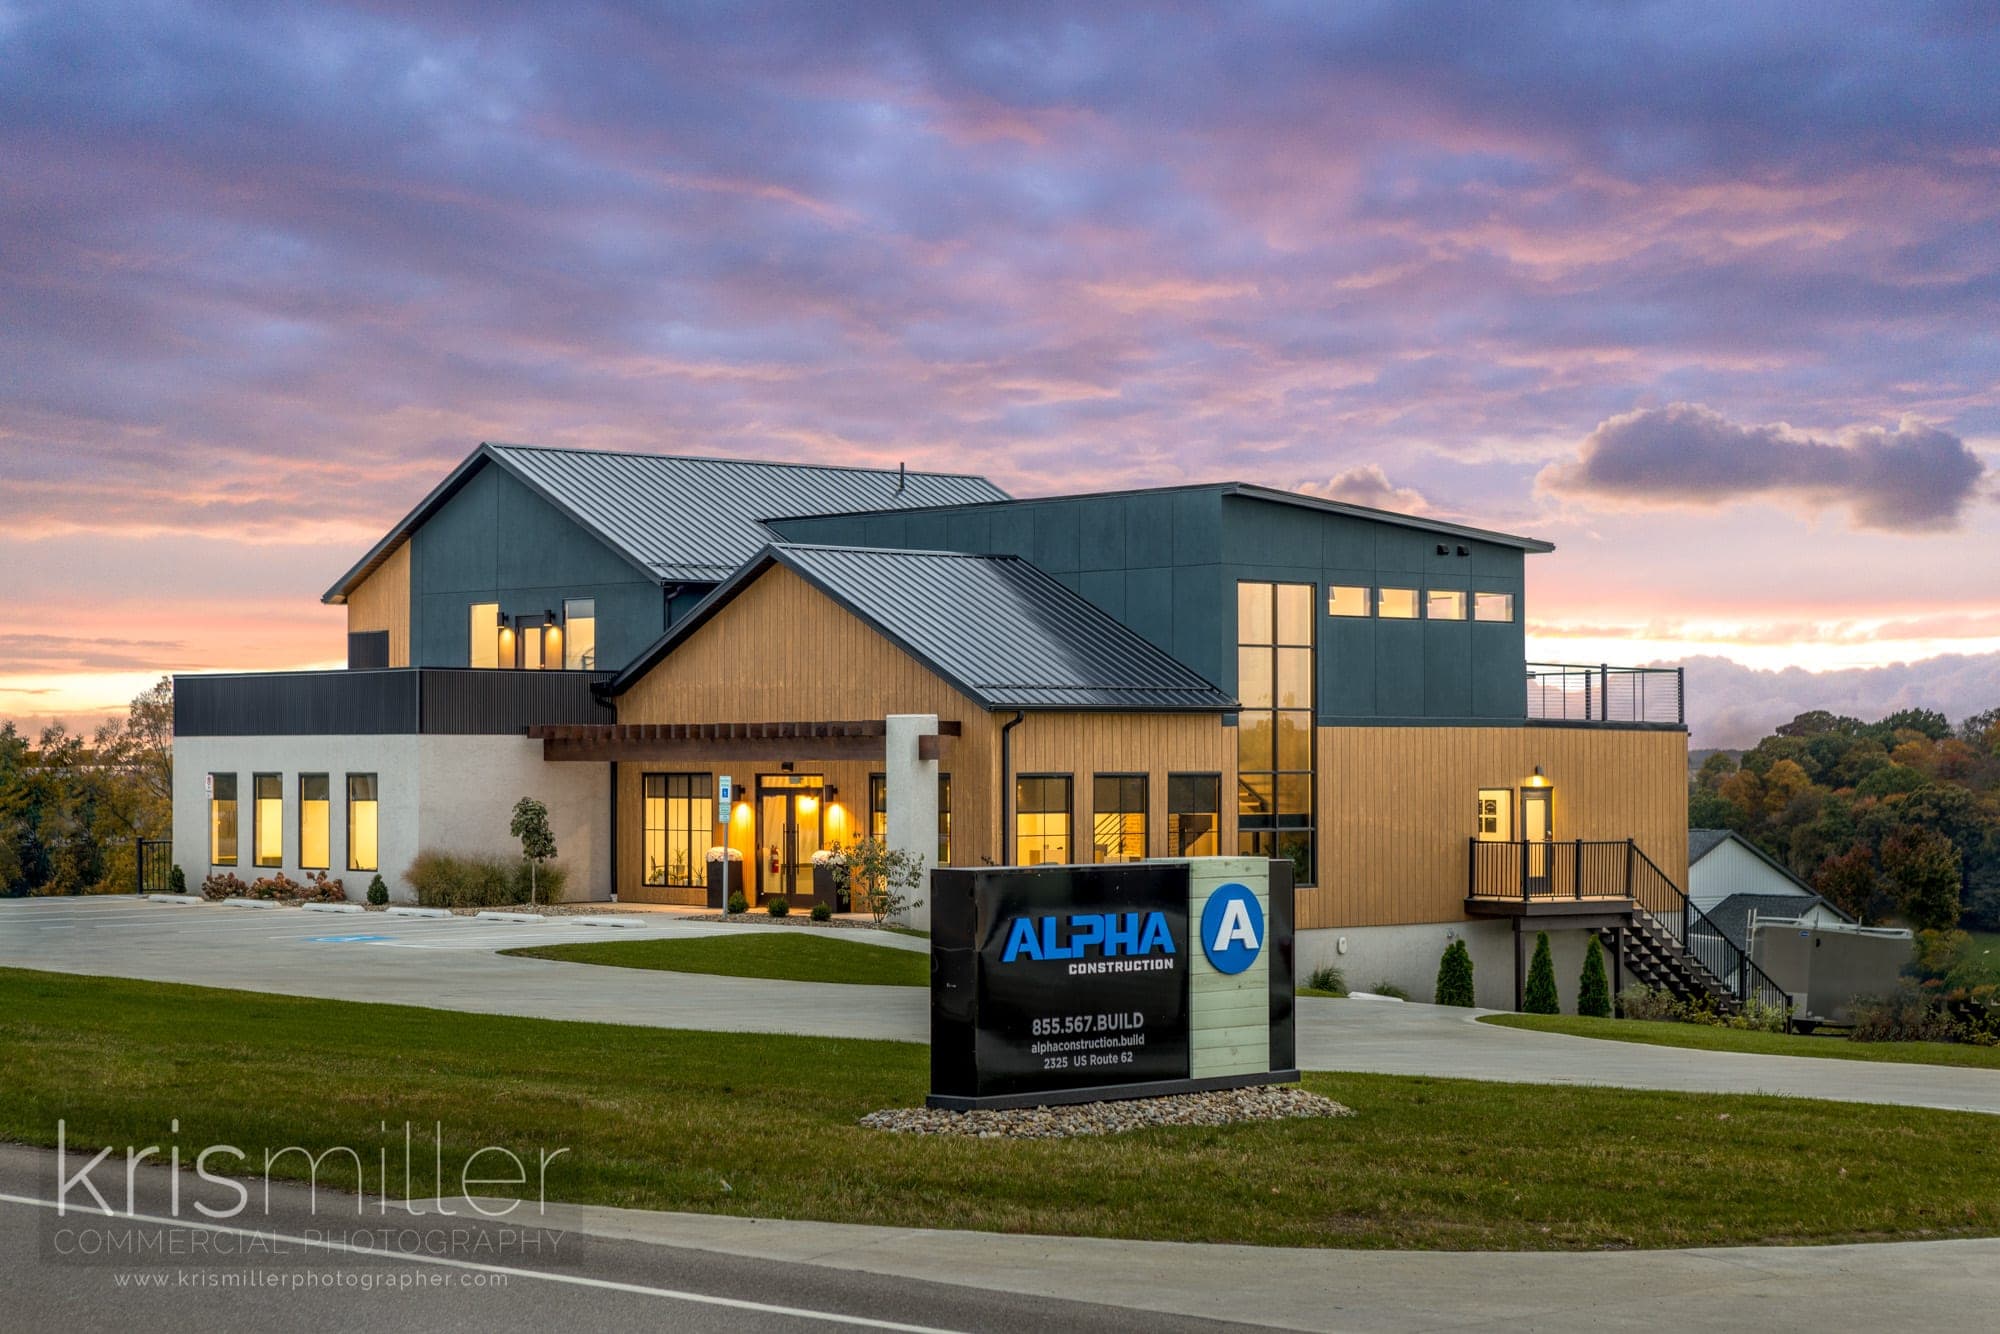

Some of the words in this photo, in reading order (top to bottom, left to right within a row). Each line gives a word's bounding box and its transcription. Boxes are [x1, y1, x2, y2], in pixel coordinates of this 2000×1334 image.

[1213, 899, 1260, 952] A
[1001, 911, 1177, 963] ALPHA
[1068, 957, 1174, 976] CONSTRUCTION
[1031, 1012, 1145, 1036] 855.567.BUILD
[1031, 1034, 1146, 1055] alphaconstruction.build
[1043, 1056, 1068, 1070] 2325
[1073, 1055, 1088, 1068] US
[1089, 1053, 1119, 1067] Route
[1120, 1051, 1134, 1064] 62
